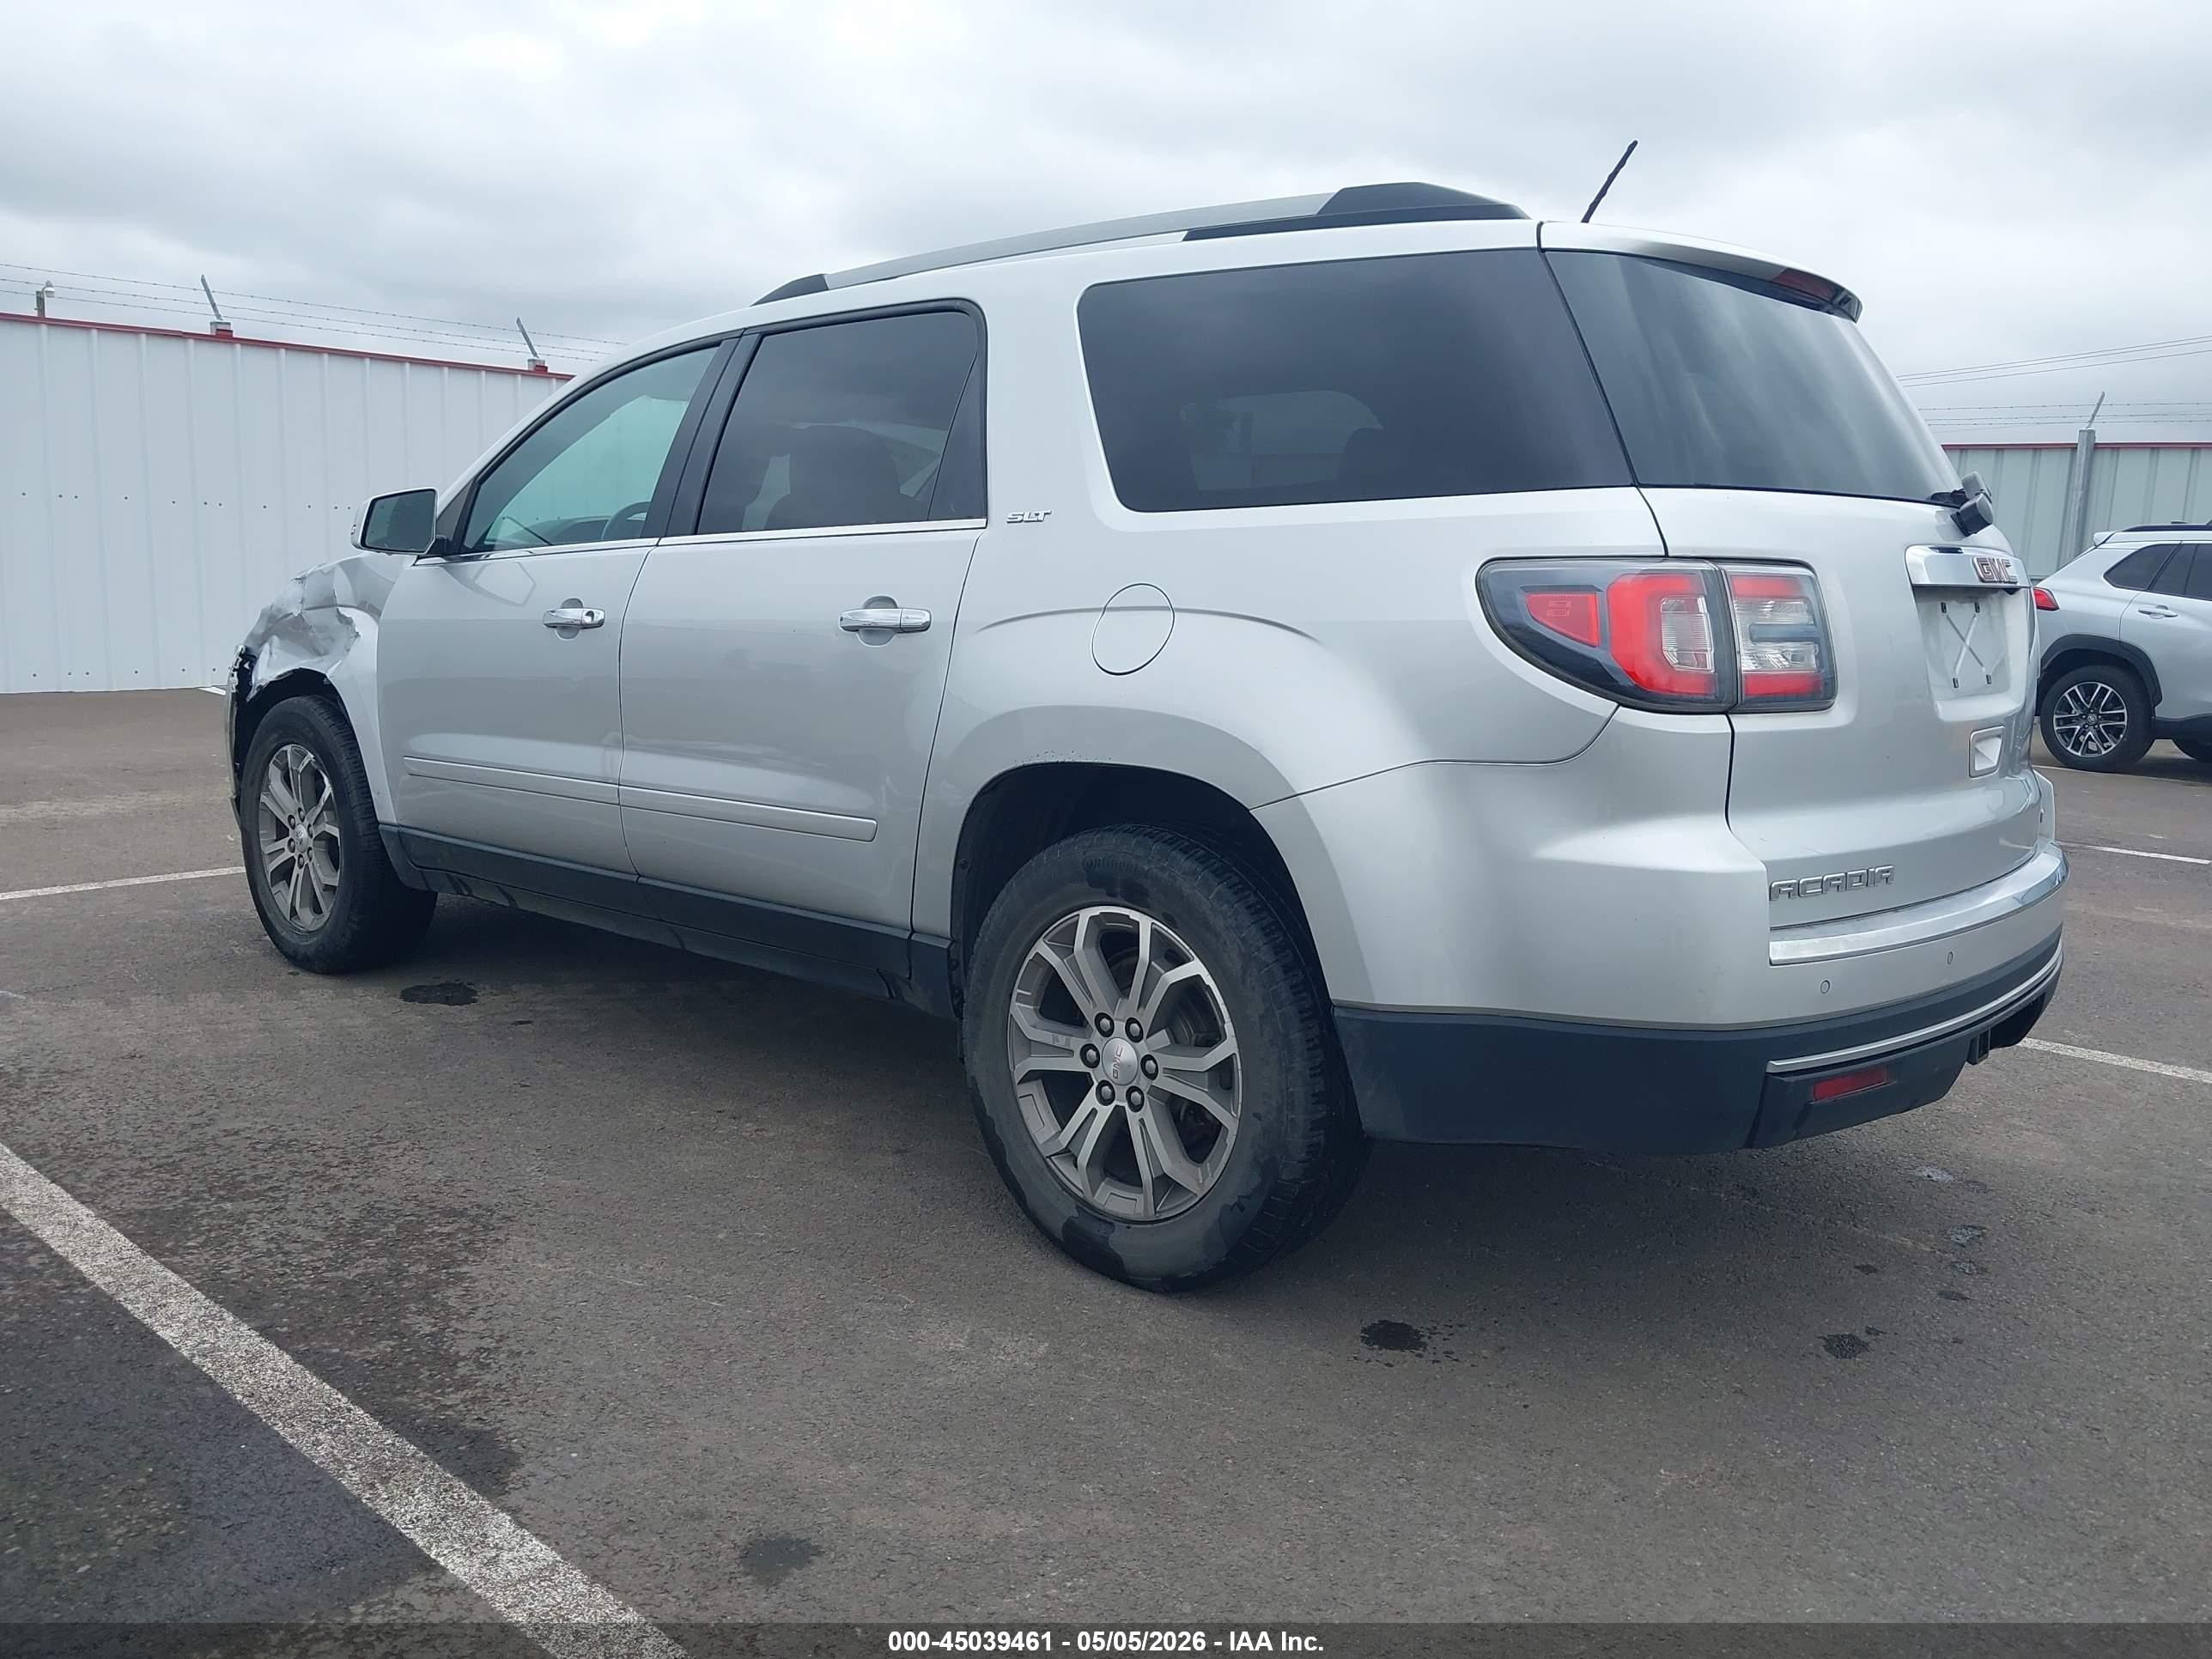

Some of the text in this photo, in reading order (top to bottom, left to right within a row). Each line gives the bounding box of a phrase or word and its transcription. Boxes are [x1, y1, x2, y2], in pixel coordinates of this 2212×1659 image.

[1006, 510, 1052, 524] SLT
[1973, 556, 2019, 584] GMC
[1769, 864, 1895, 901] ACADIA
[1112, 1044, 1123, 1079] GMC
